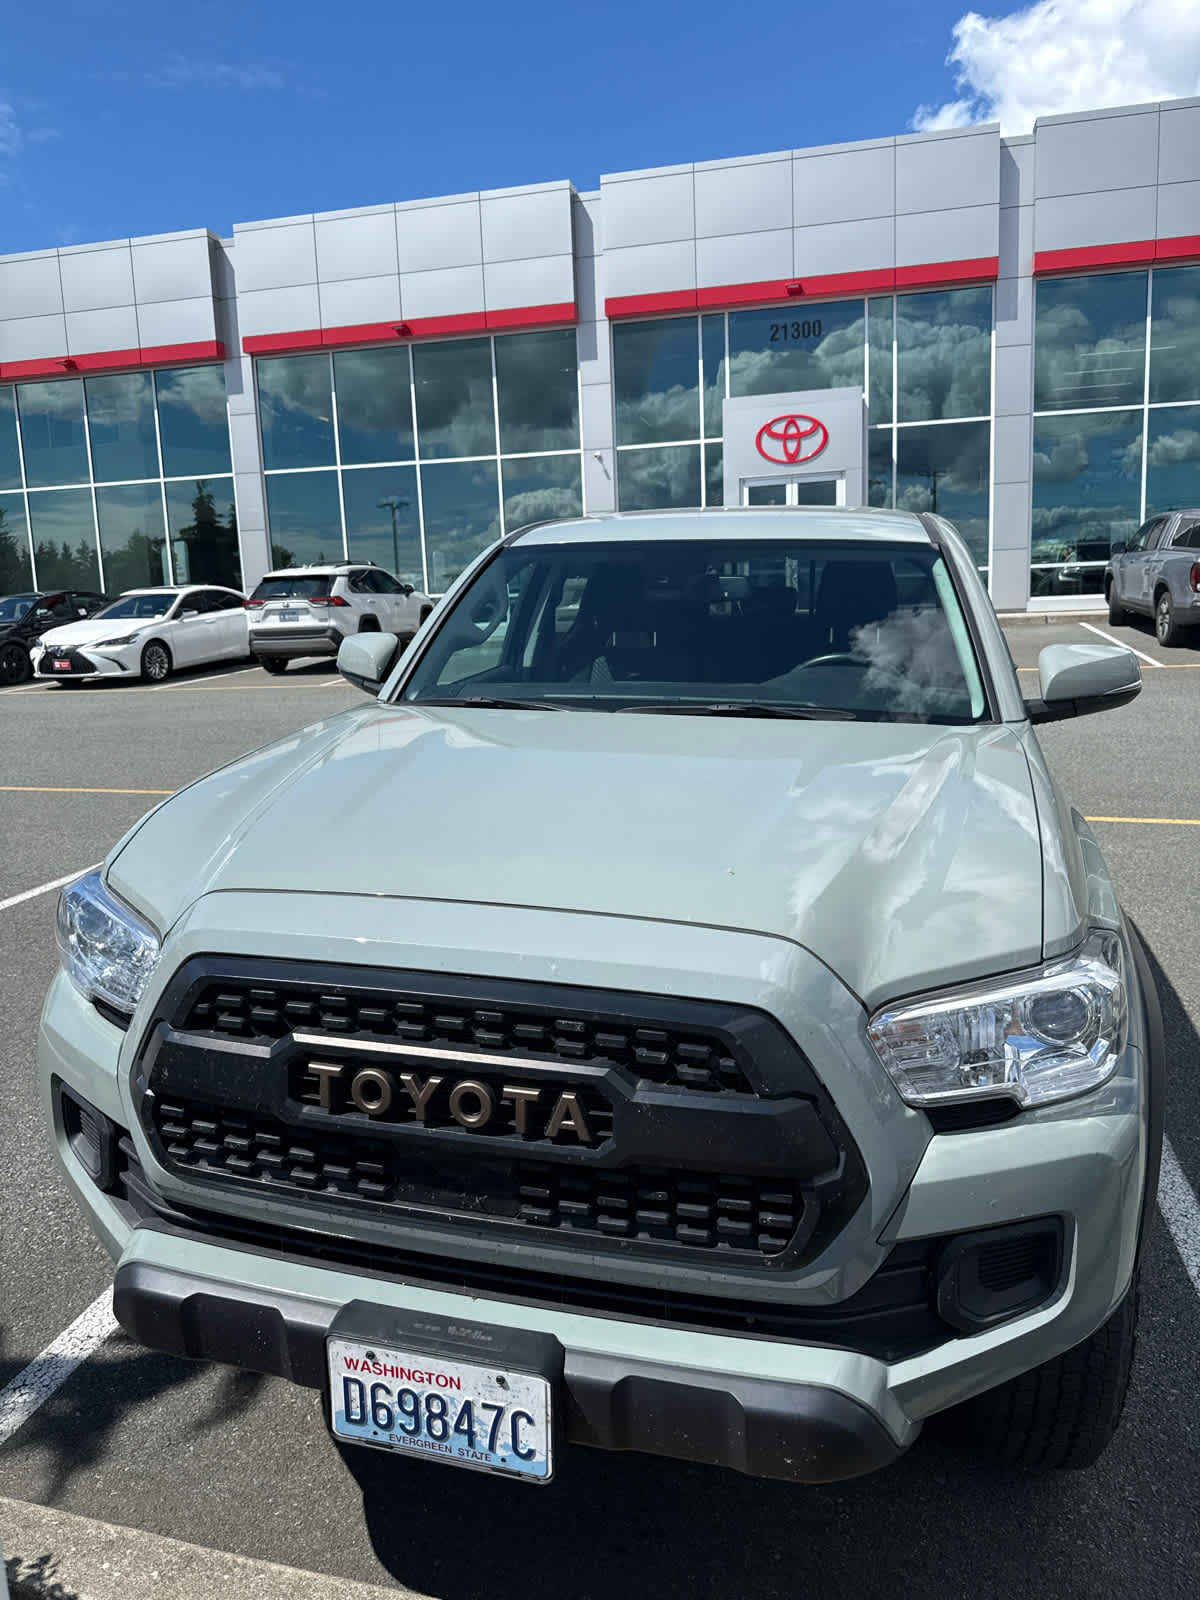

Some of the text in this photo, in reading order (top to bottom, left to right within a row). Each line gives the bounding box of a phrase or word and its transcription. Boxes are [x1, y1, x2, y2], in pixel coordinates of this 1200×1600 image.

[769, 319, 822, 342] 21300
[307, 1061, 592, 1142] TOYOTA
[344, 1356, 461, 1390] WASHINGTON
[342, 1375, 536, 1461] D69847C
[389, 1433, 492, 1462] EVERGREEN STATE
